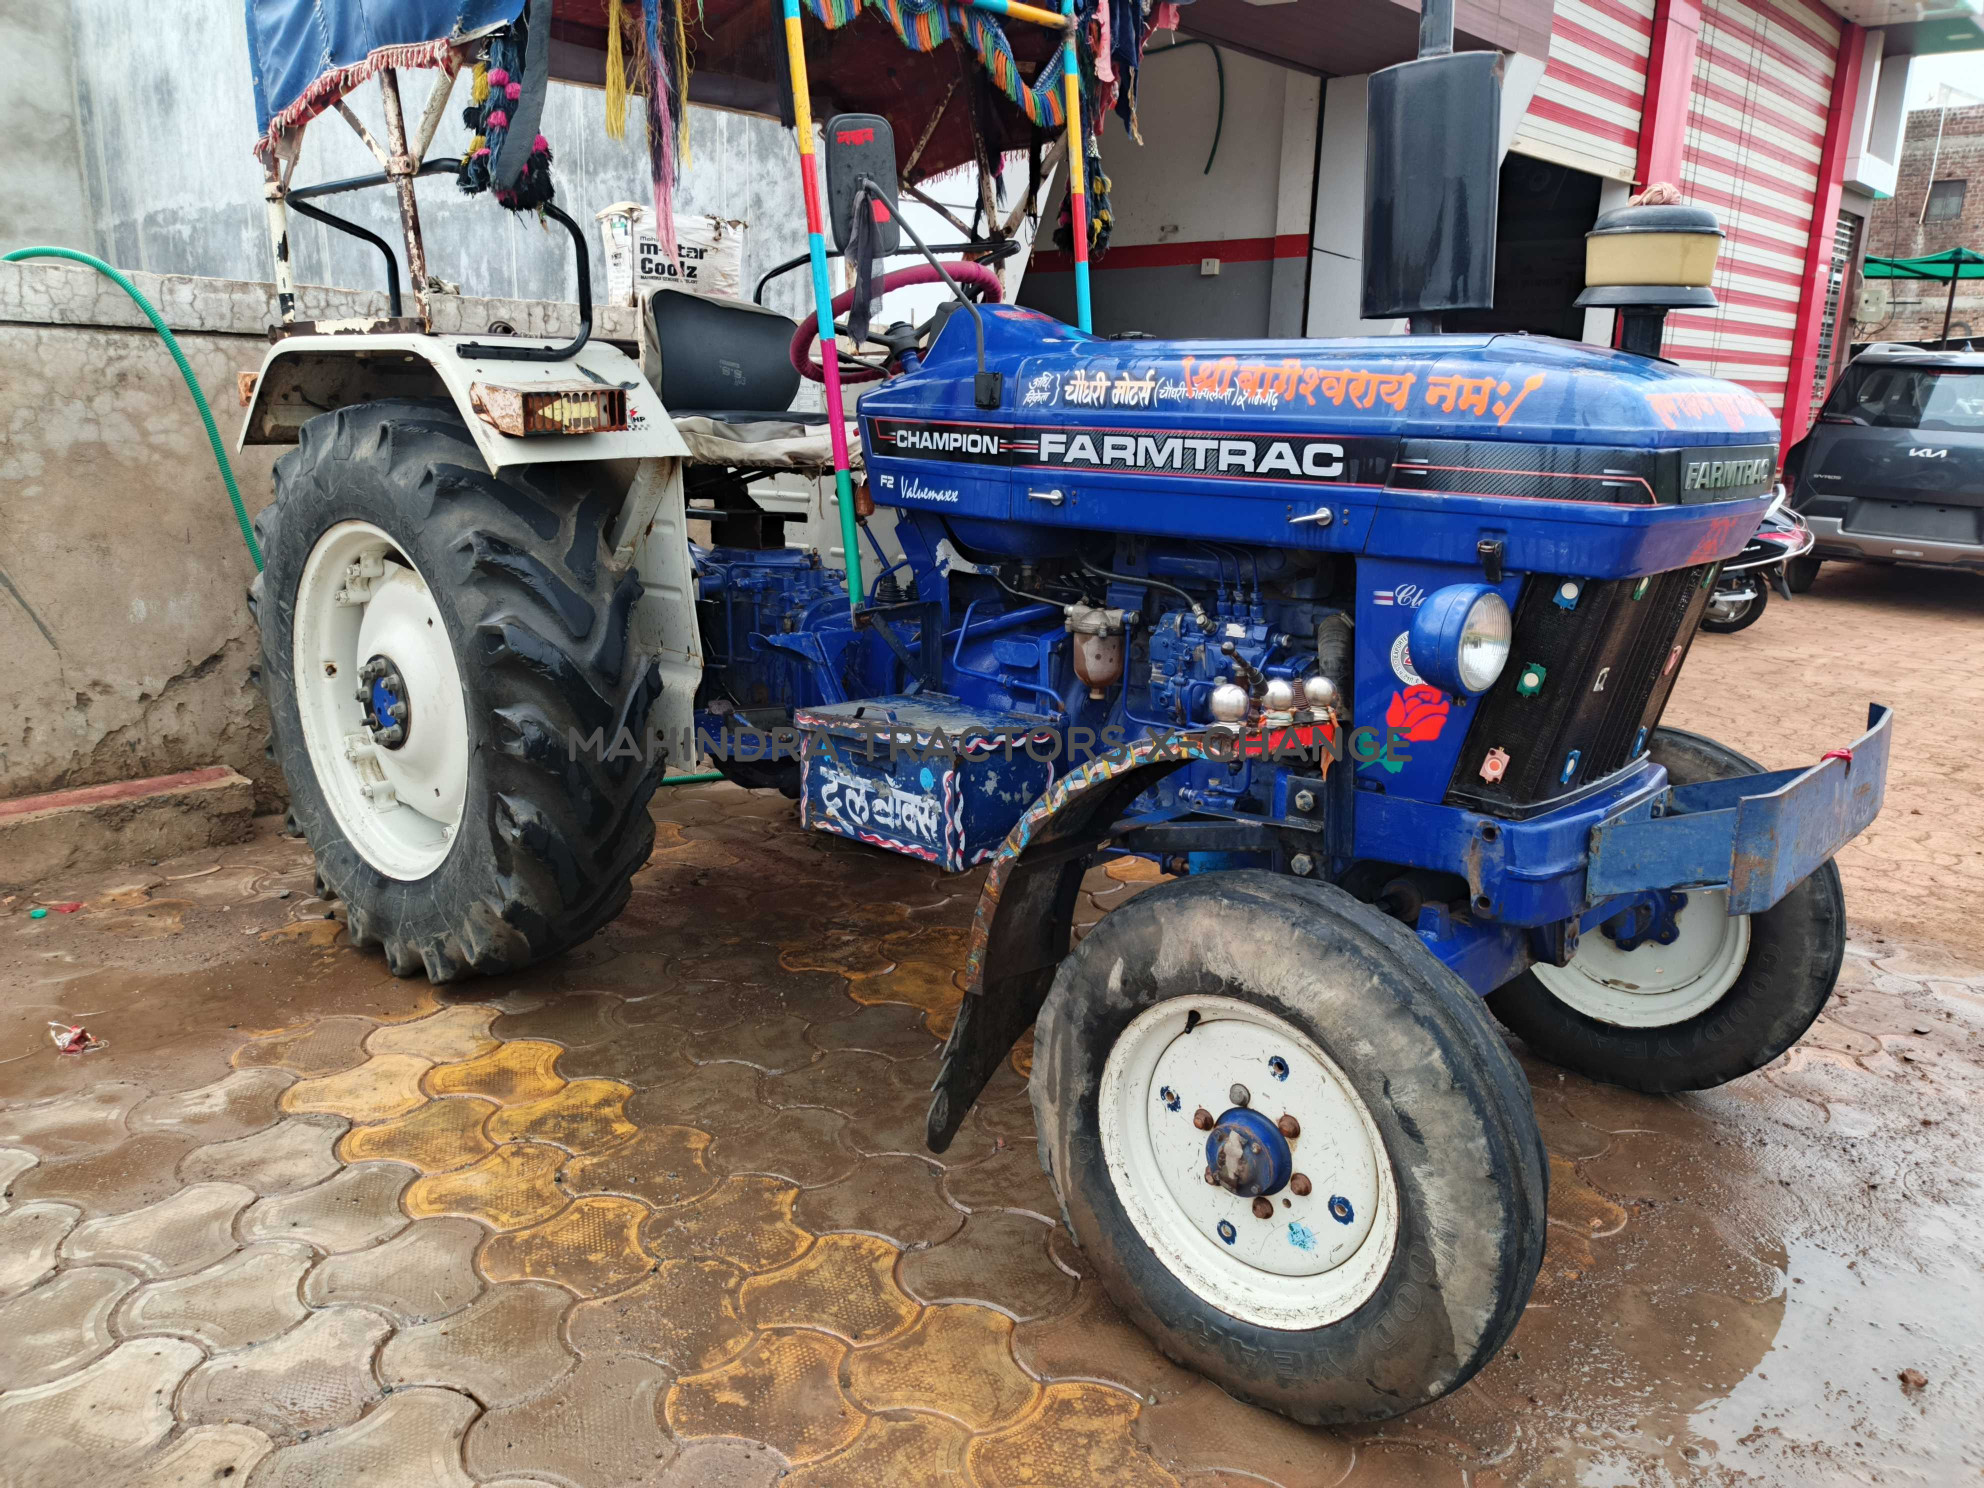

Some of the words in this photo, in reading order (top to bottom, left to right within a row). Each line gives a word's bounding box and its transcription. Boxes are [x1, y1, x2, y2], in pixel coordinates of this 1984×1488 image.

[640, 242, 708, 260] m-tar
[1064, 369, 1112, 405] चौधरी
[1112, 369, 1156, 406] मोटर्स
[896, 429, 999, 455] CHAMPION
[1039, 433, 1344, 477] FARMTRAC
[1908, 447, 1948, 459] KIA
[880, 474, 895, 489] F2
[900, 475, 959, 503] Valuemaxx
[1684, 459, 1770, 490] FARMTRAC
